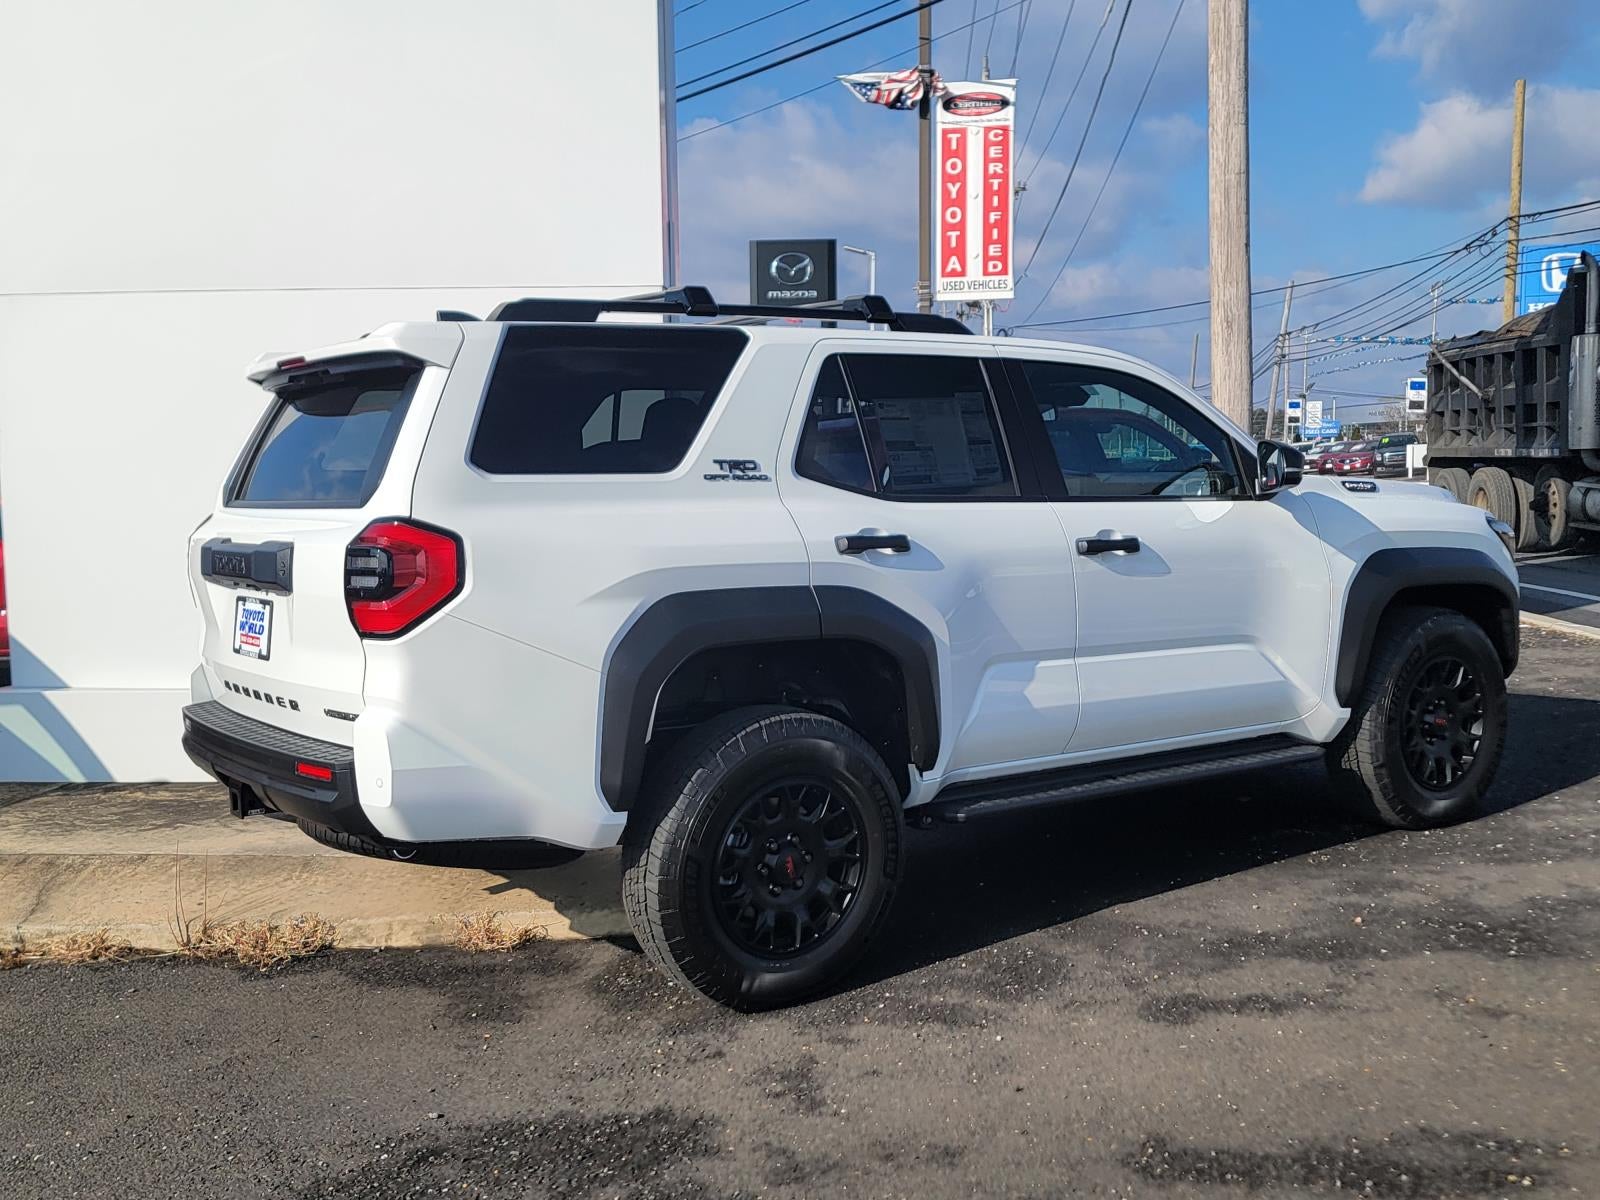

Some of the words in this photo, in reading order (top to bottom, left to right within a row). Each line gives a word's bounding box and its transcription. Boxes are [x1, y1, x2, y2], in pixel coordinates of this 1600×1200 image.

[945, 133, 963, 273] TOYOTA
[988, 129, 1004, 273] CERTIFIED
[942, 280, 965, 291] USED
[966, 279, 1008, 290] VEHICLES
[712, 459, 758, 473] TRD
[703, 473, 730, 481] OFF
[732, 473, 769, 481] ROAD
[241, 607, 266, 623] TOYOTA
